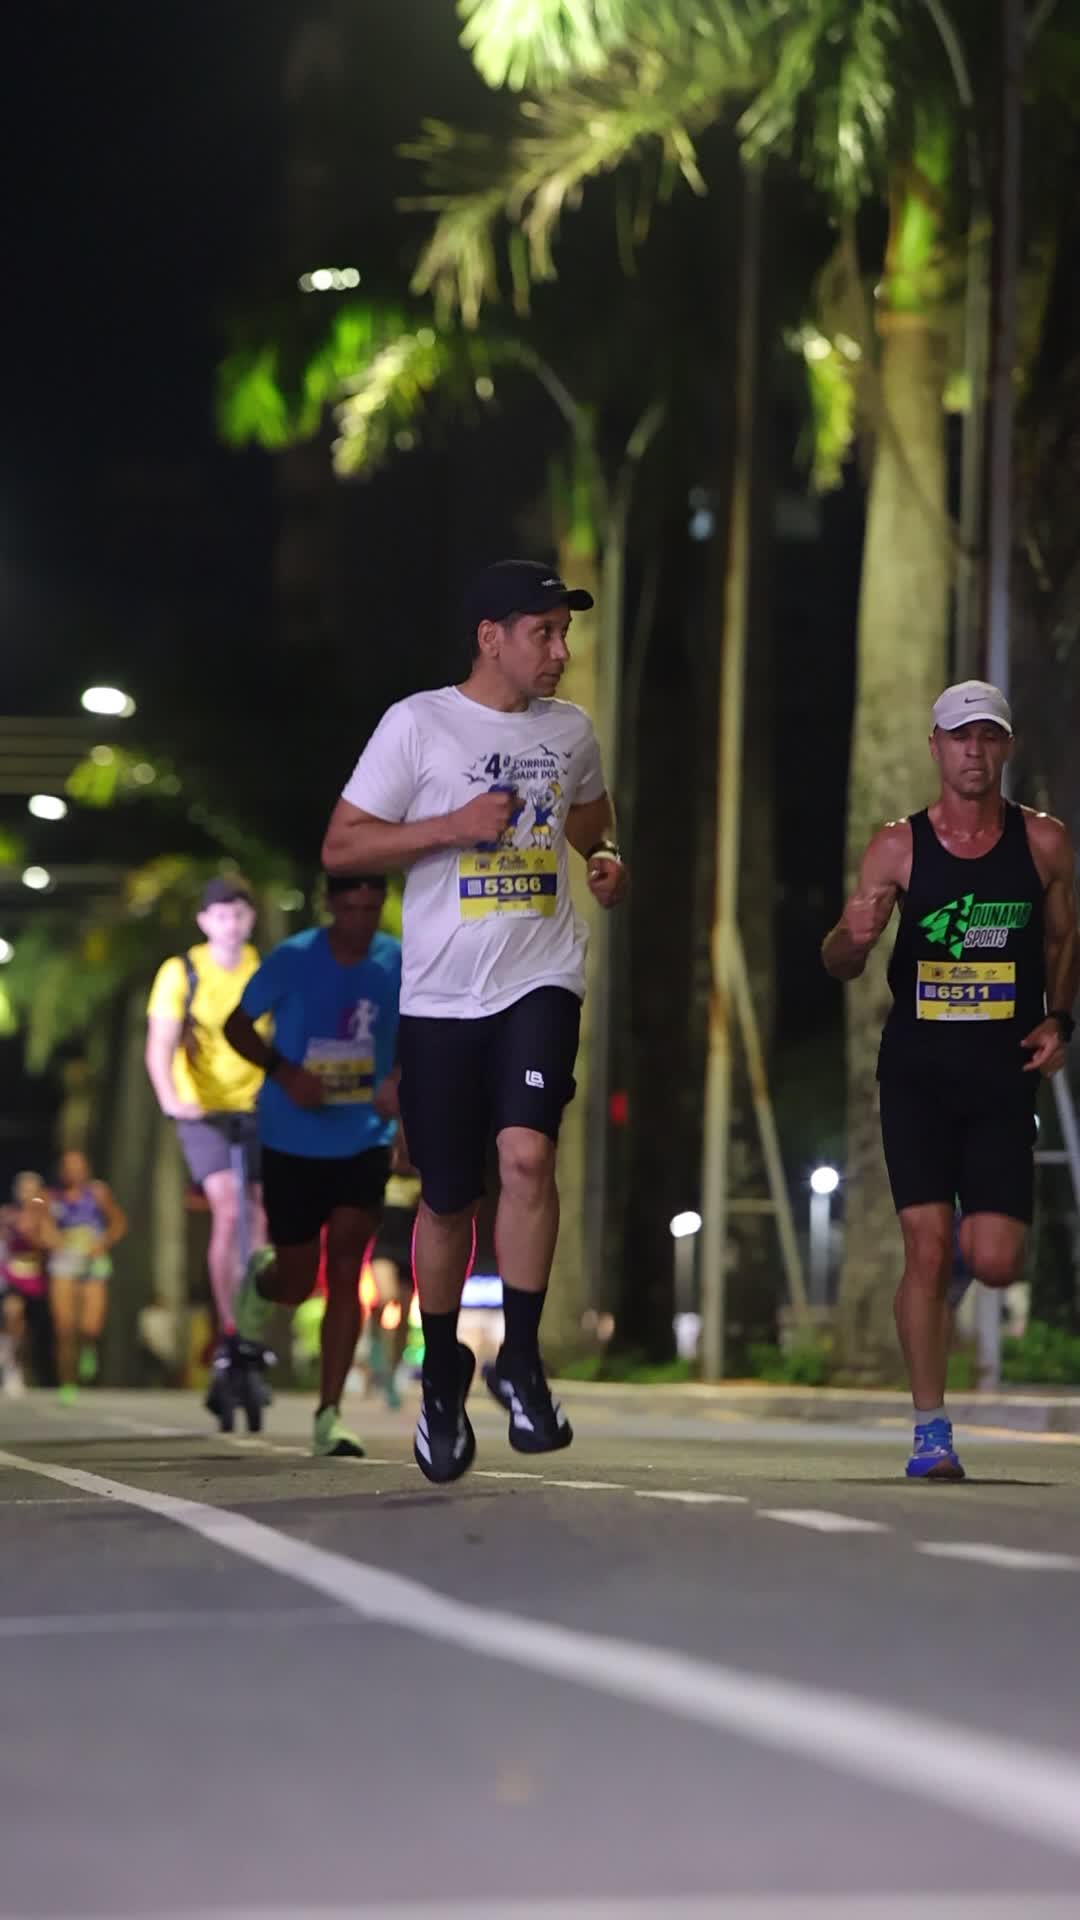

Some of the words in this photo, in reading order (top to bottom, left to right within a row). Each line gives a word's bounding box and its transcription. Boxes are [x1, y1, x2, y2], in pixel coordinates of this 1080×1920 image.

[513, 759, 555, 769] CORRIDA
[484, 876, 542, 895] 5366
[963, 927, 1009, 948] SPORTS
[937, 985, 989, 999] 6511
